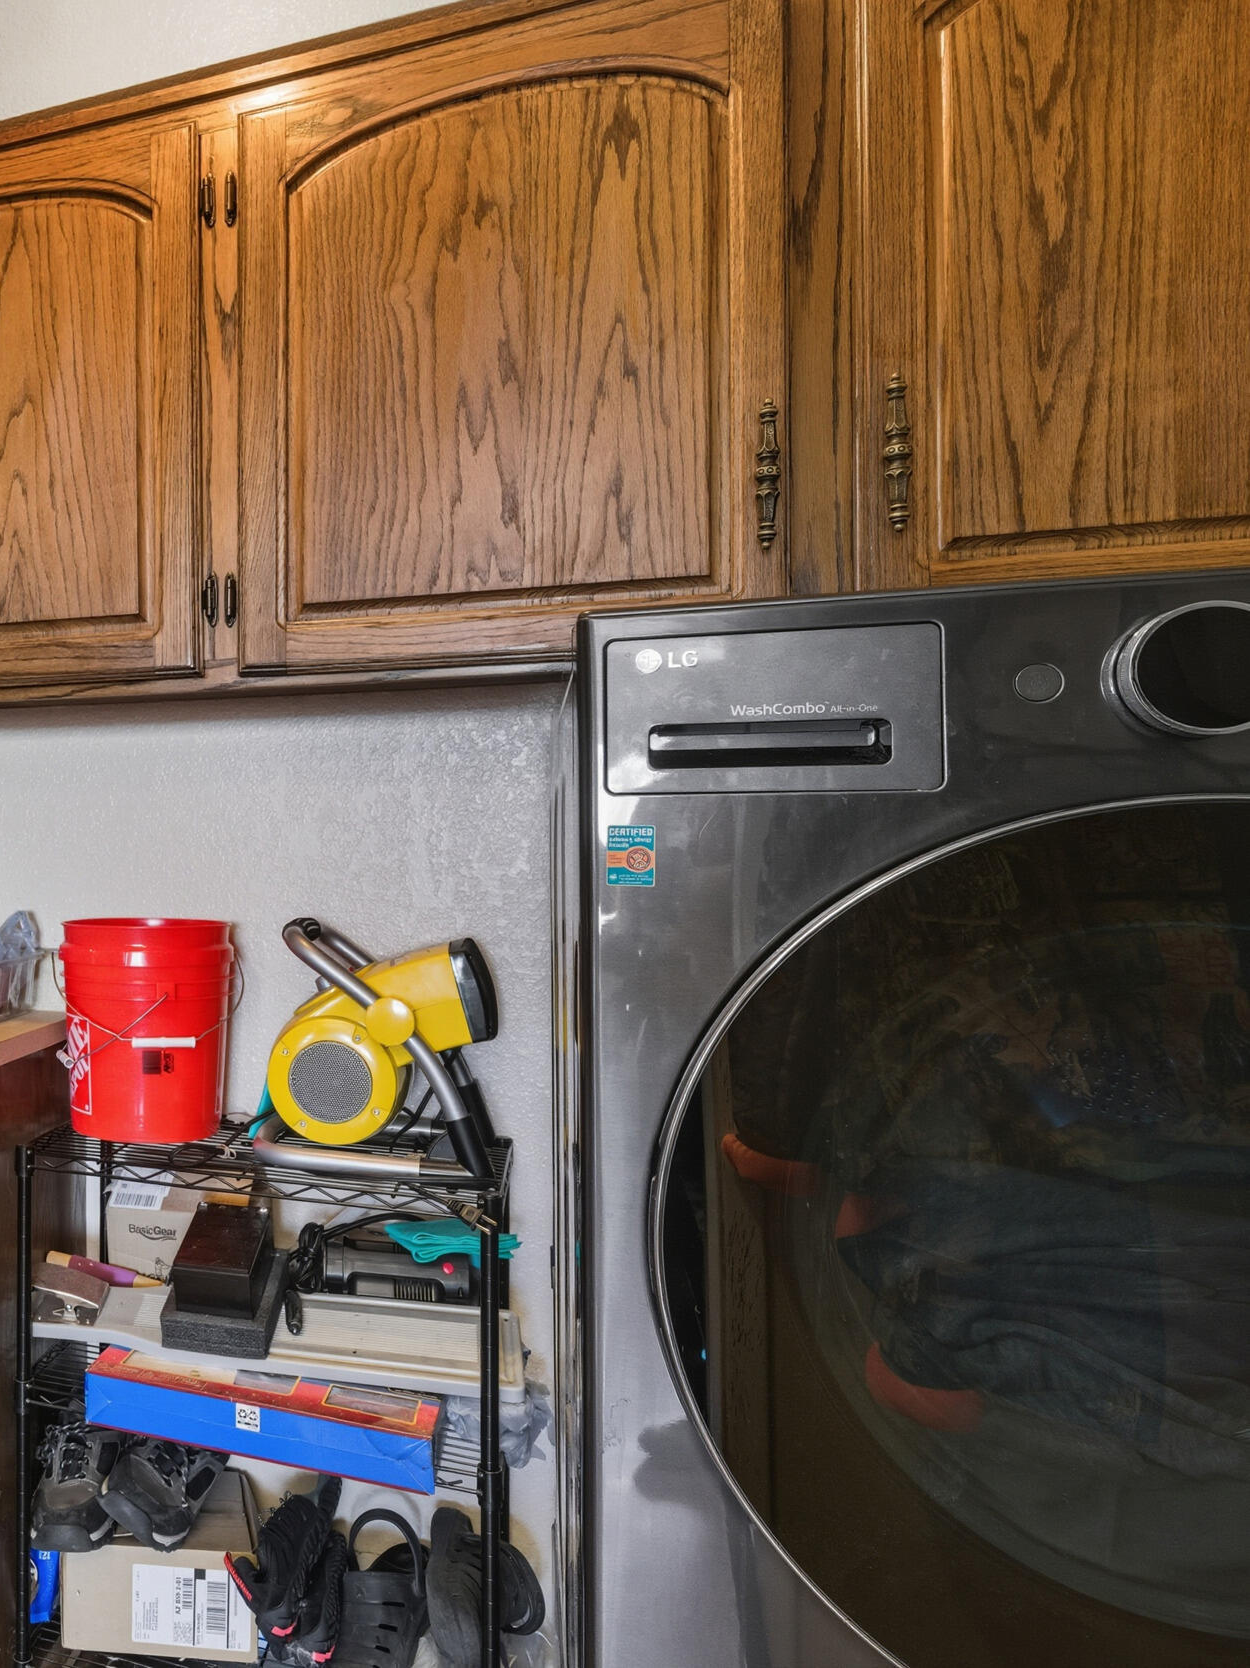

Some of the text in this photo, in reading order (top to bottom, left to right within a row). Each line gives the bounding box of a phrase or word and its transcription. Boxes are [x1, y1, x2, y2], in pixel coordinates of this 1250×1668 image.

[668, 650, 699, 669] LG
[609, 827, 653, 837] CERTIFIED
[129, 1224, 177, 1237] BasicGear
